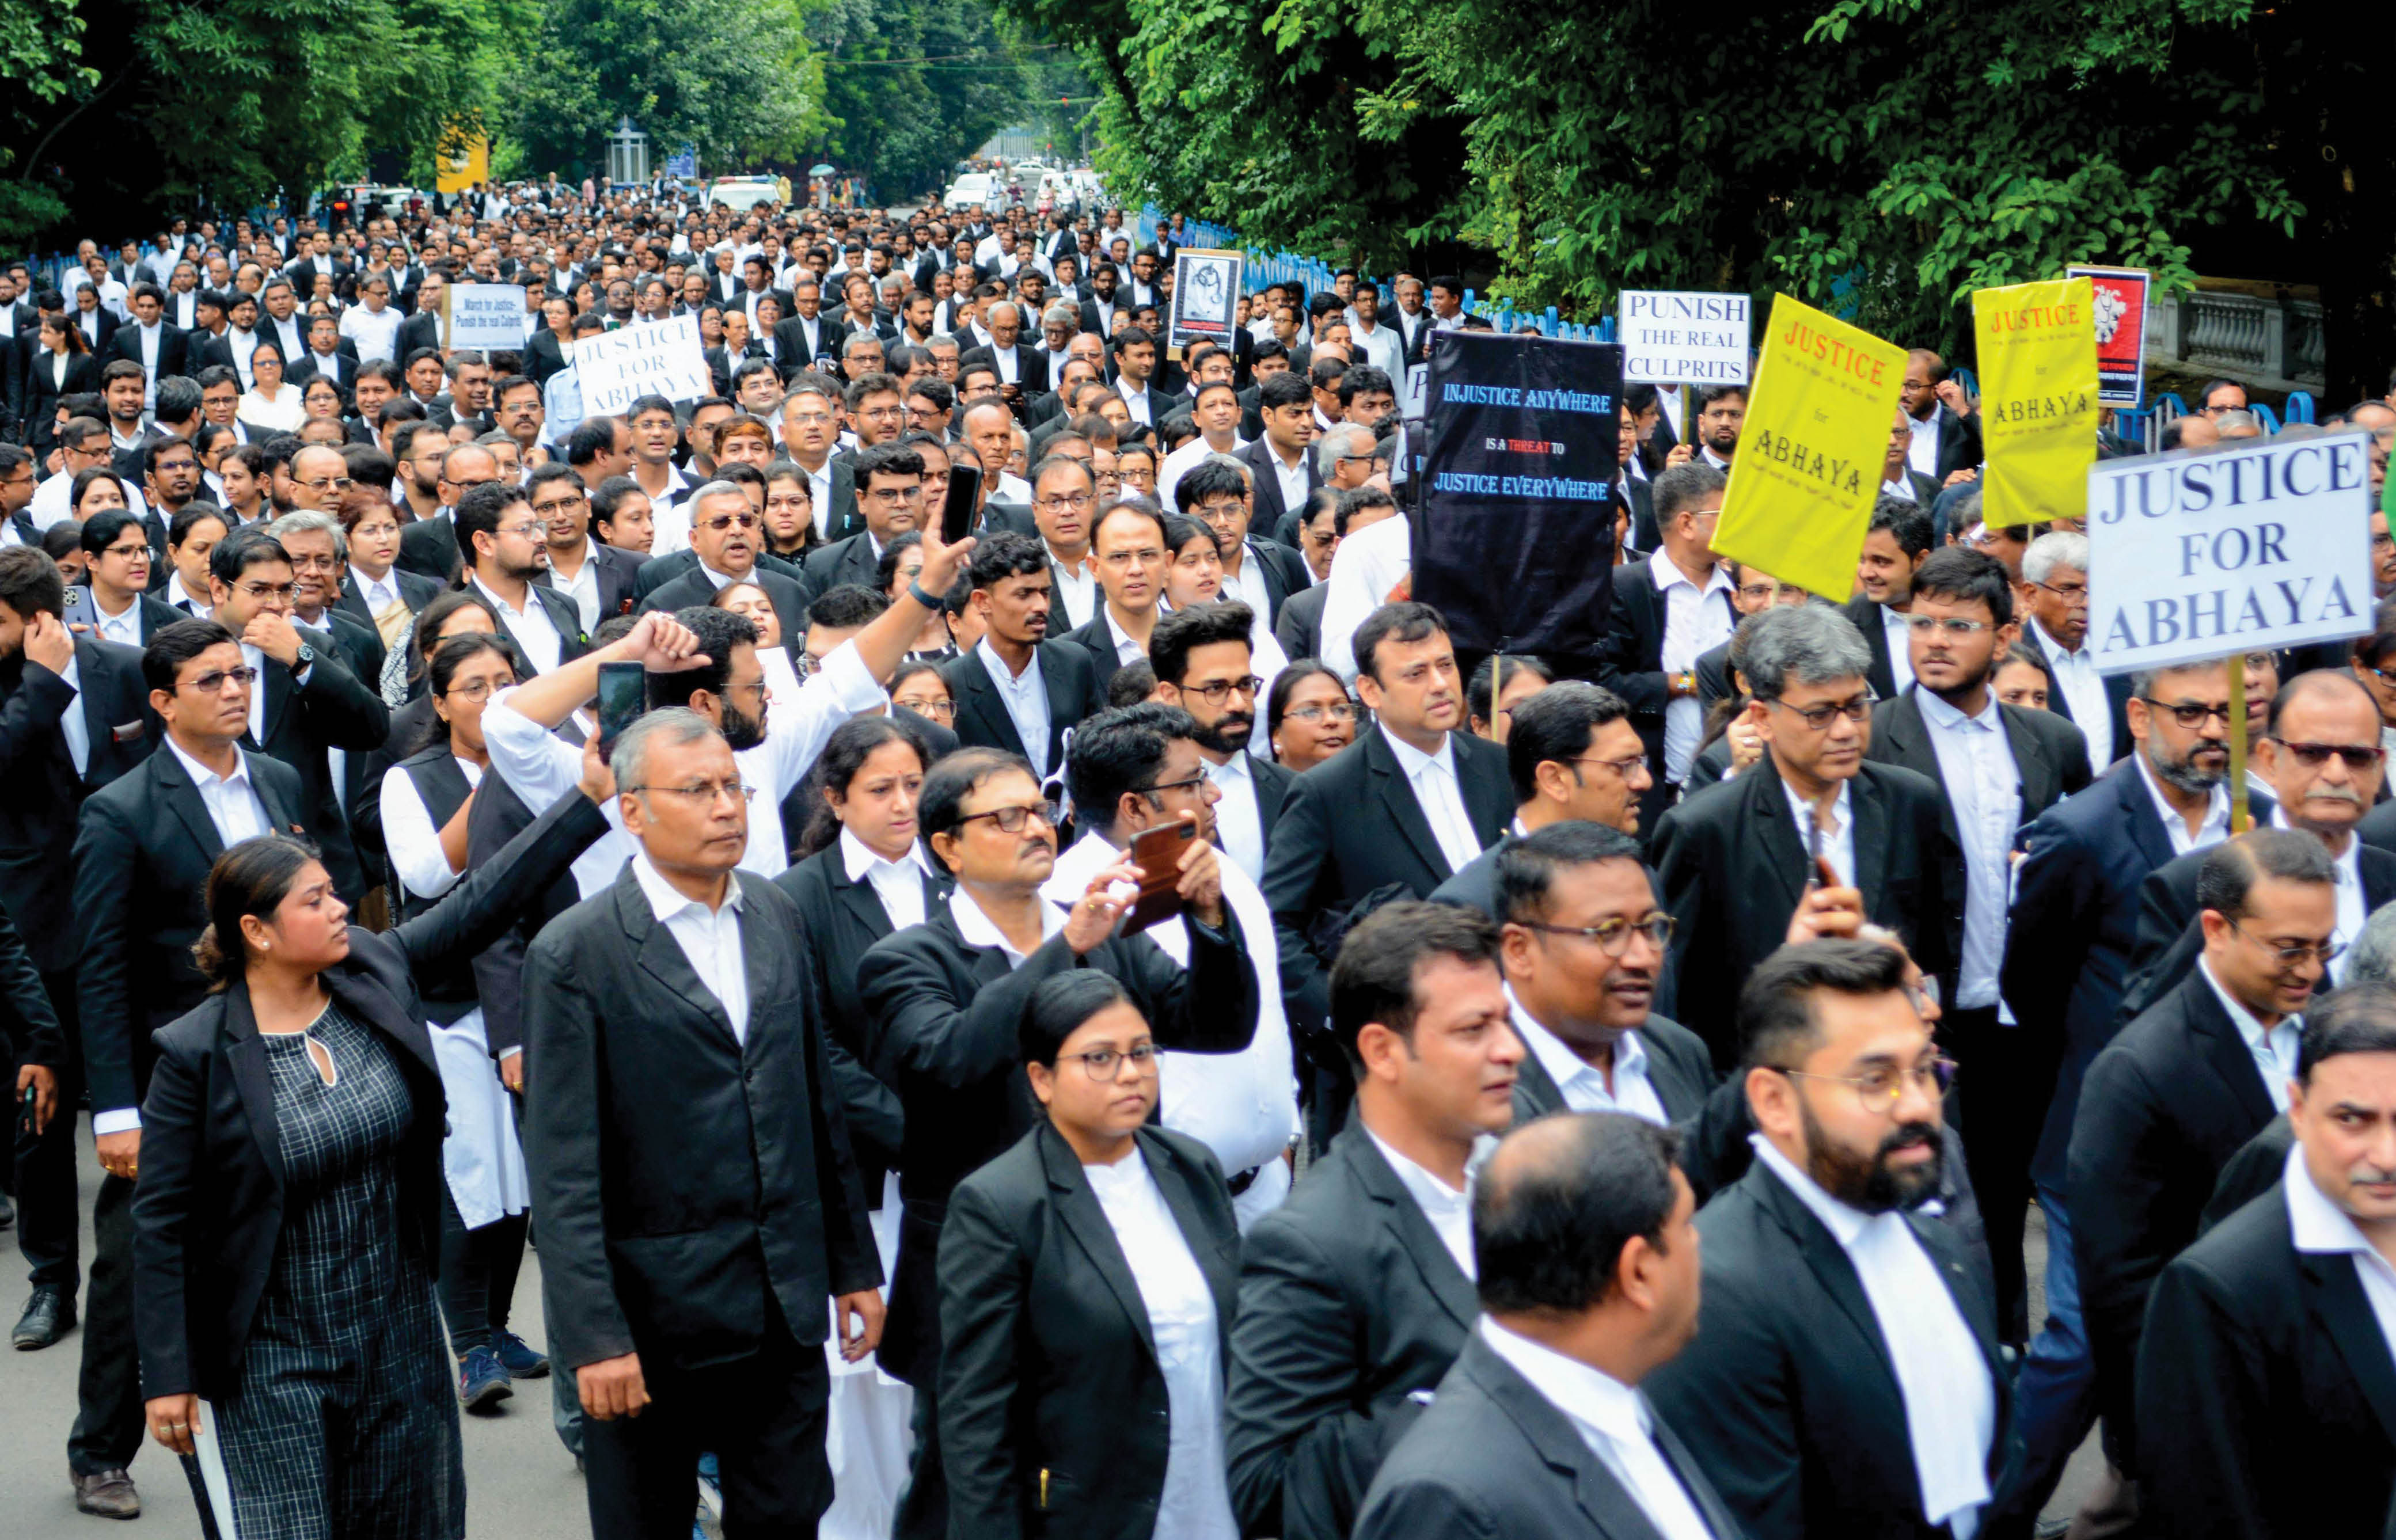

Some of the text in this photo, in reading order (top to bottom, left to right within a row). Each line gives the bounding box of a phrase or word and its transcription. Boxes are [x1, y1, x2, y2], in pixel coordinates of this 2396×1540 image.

[465, 298, 483, 310] March
[1630, 295, 1746, 322] PUNISH
[1991, 304, 2080, 333] JUSTICE
[455, 314, 476, 328] Punish
[478, 315, 487, 328] the
[582, 321, 692, 364] JUSTICE
[1639, 329, 1738, 348] THE REAL
[618, 355, 666, 379] FOR
[1628, 358, 1742, 379] CULPRITS
[1784, 321, 1886, 387] JUSTICE
[590, 373, 699, 413] ABHAYA
[1444, 383, 1521, 406] INJUSTICE
[1524, 388, 1612, 414] ANYWHERE
[1994, 391, 2088, 424] ABHAYA
[1813, 408, 1829, 424] for
[1485, 438, 1565, 455] IS A THREAT TO
[1753, 429, 1862, 496] ABHAYA
[1434, 472, 1608, 501] JUSTICE EVERYWHERE
[2099, 442, 2363, 525] JUSTICE
[2177, 522, 2291, 577] FOR
[2101, 573, 2360, 653] ABHAYA
